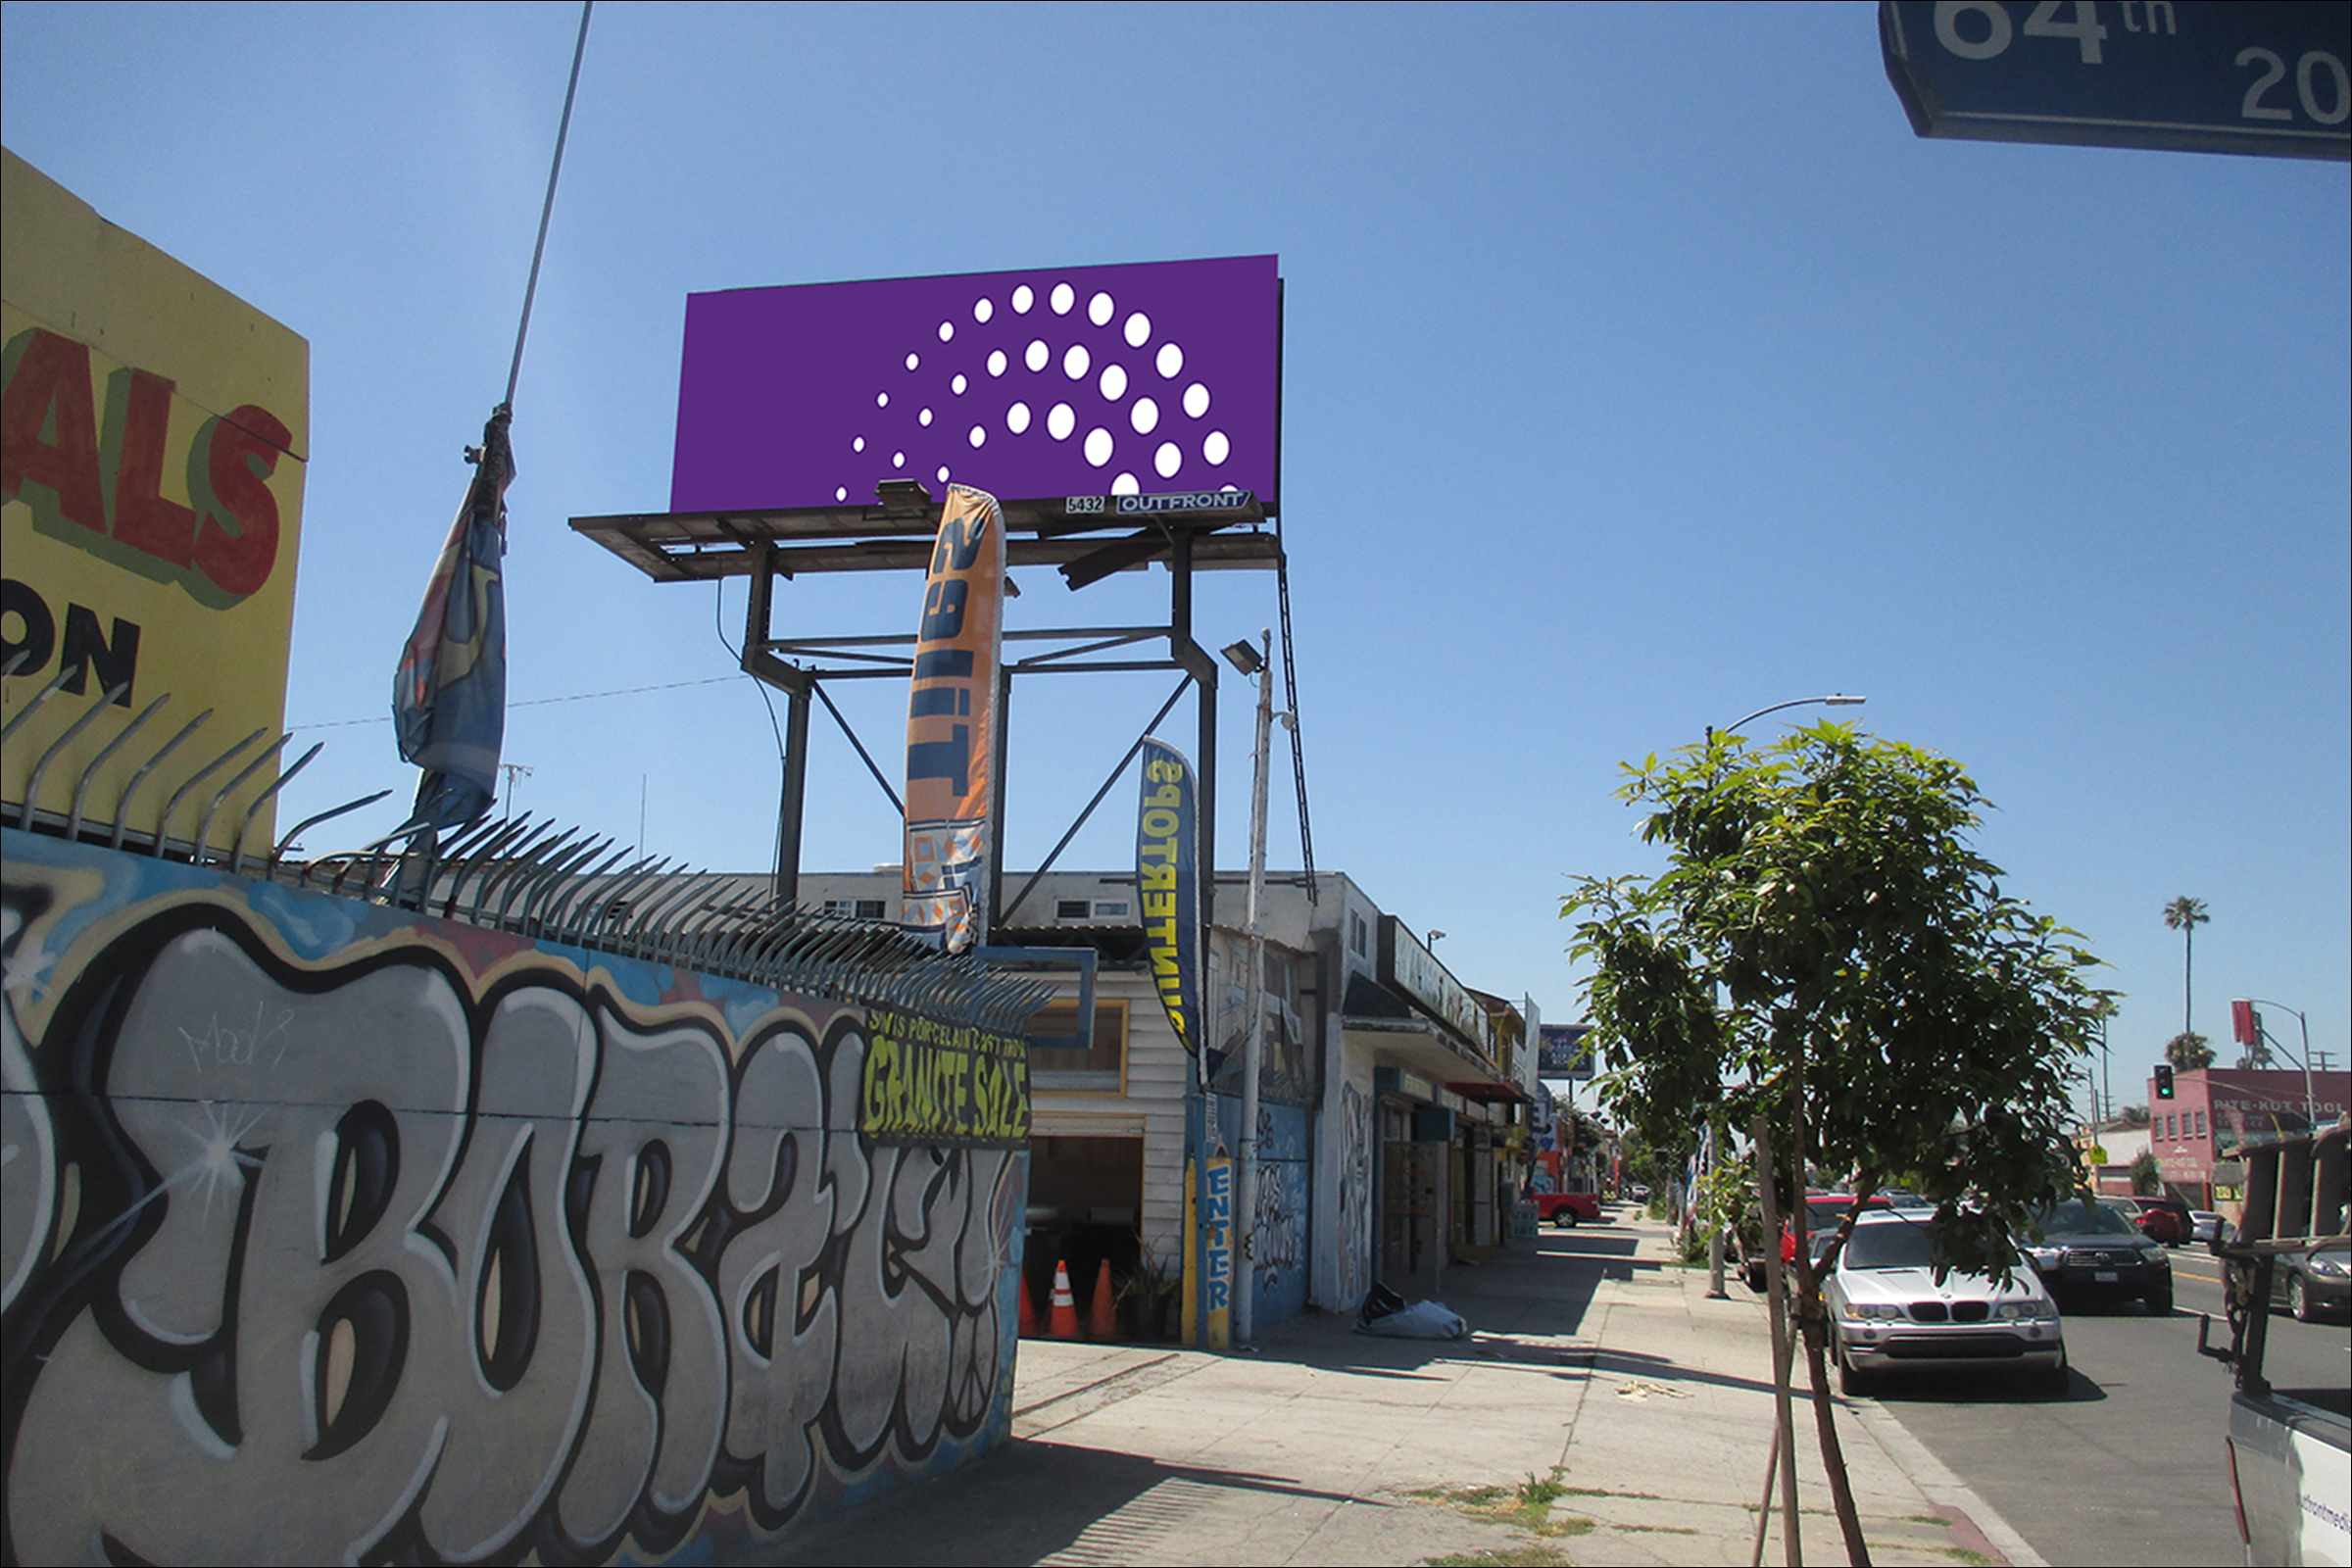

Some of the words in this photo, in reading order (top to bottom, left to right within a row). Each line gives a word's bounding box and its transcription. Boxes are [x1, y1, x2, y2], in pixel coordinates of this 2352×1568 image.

[0, 326, 292, 603] ALS
[1067, 497, 1103, 513] 5432
[1122, 493, 1245, 511] OUTFRONT
[863, 1035, 969, 1135] GRANITE
[973, 1054, 1029, 1139] SALE
[1206, 1165, 1231, 1313] ENTER
